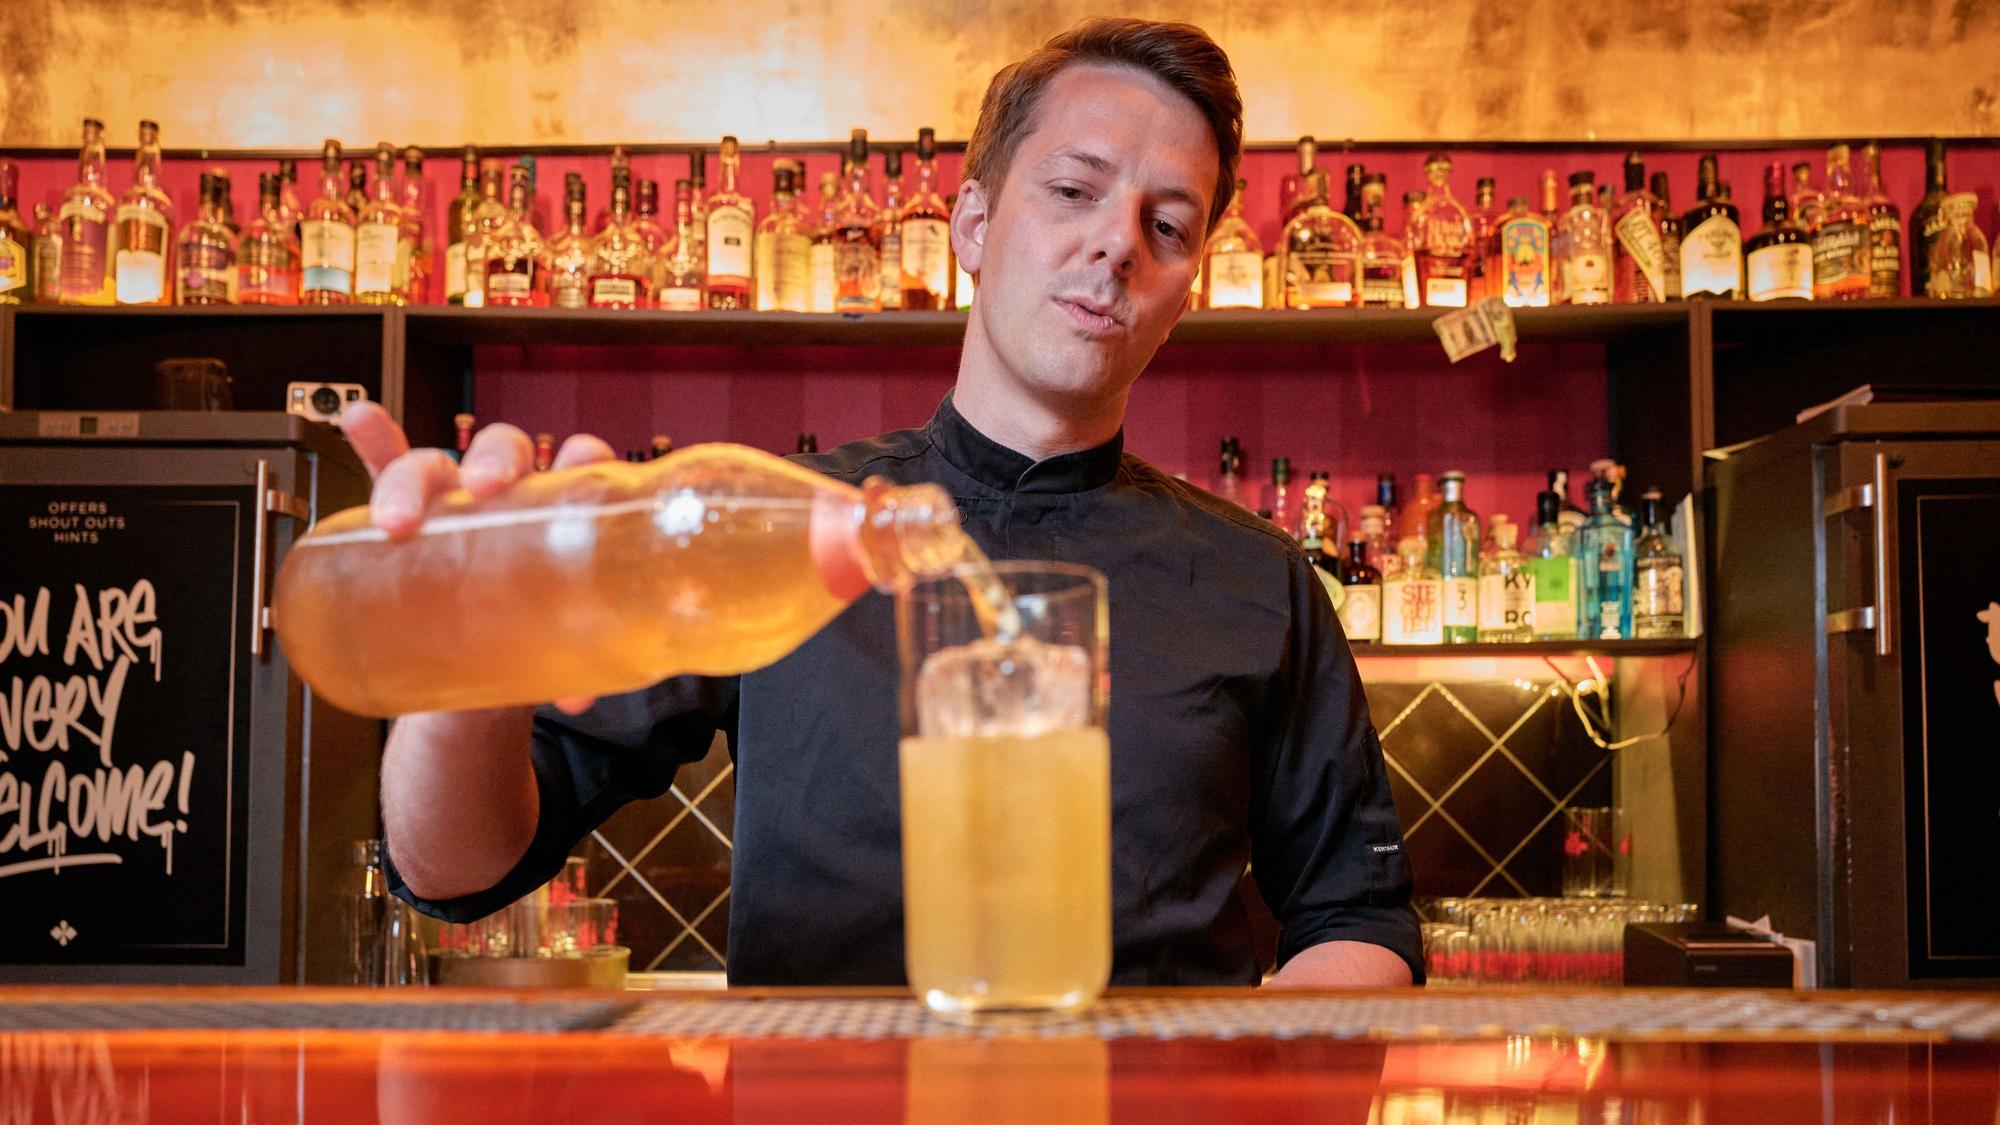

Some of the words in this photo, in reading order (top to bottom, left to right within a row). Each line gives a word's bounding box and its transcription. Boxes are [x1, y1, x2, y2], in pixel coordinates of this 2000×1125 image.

[48, 501, 108, 514] OFFERS
[29, 516, 80, 529] SHOUT
[85, 516, 126, 529] OUTS
[53, 531, 98, 544] HINTS
